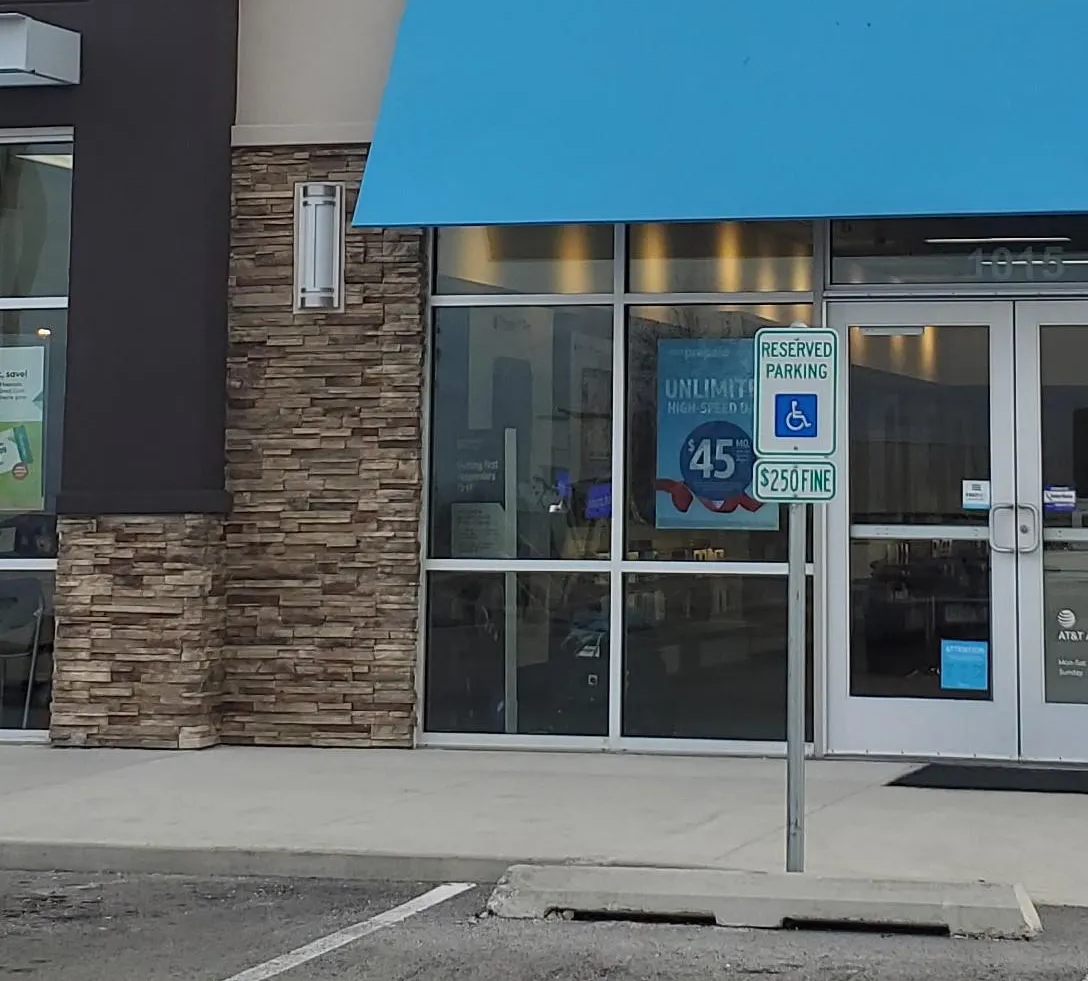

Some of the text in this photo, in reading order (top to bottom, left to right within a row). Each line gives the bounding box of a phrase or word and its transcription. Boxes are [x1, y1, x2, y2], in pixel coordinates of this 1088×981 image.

[967, 246, 1065, 280] 1015
[761, 342, 833, 358] RESERVED
[766, 363, 828, 380] PARKING
[667, 400, 737, 415] HIGH-SPEED
[688, 438, 736, 479] $45
[760, 467, 832, 493] $250 FINE
[1058, 631, 1084, 641] AT&T
